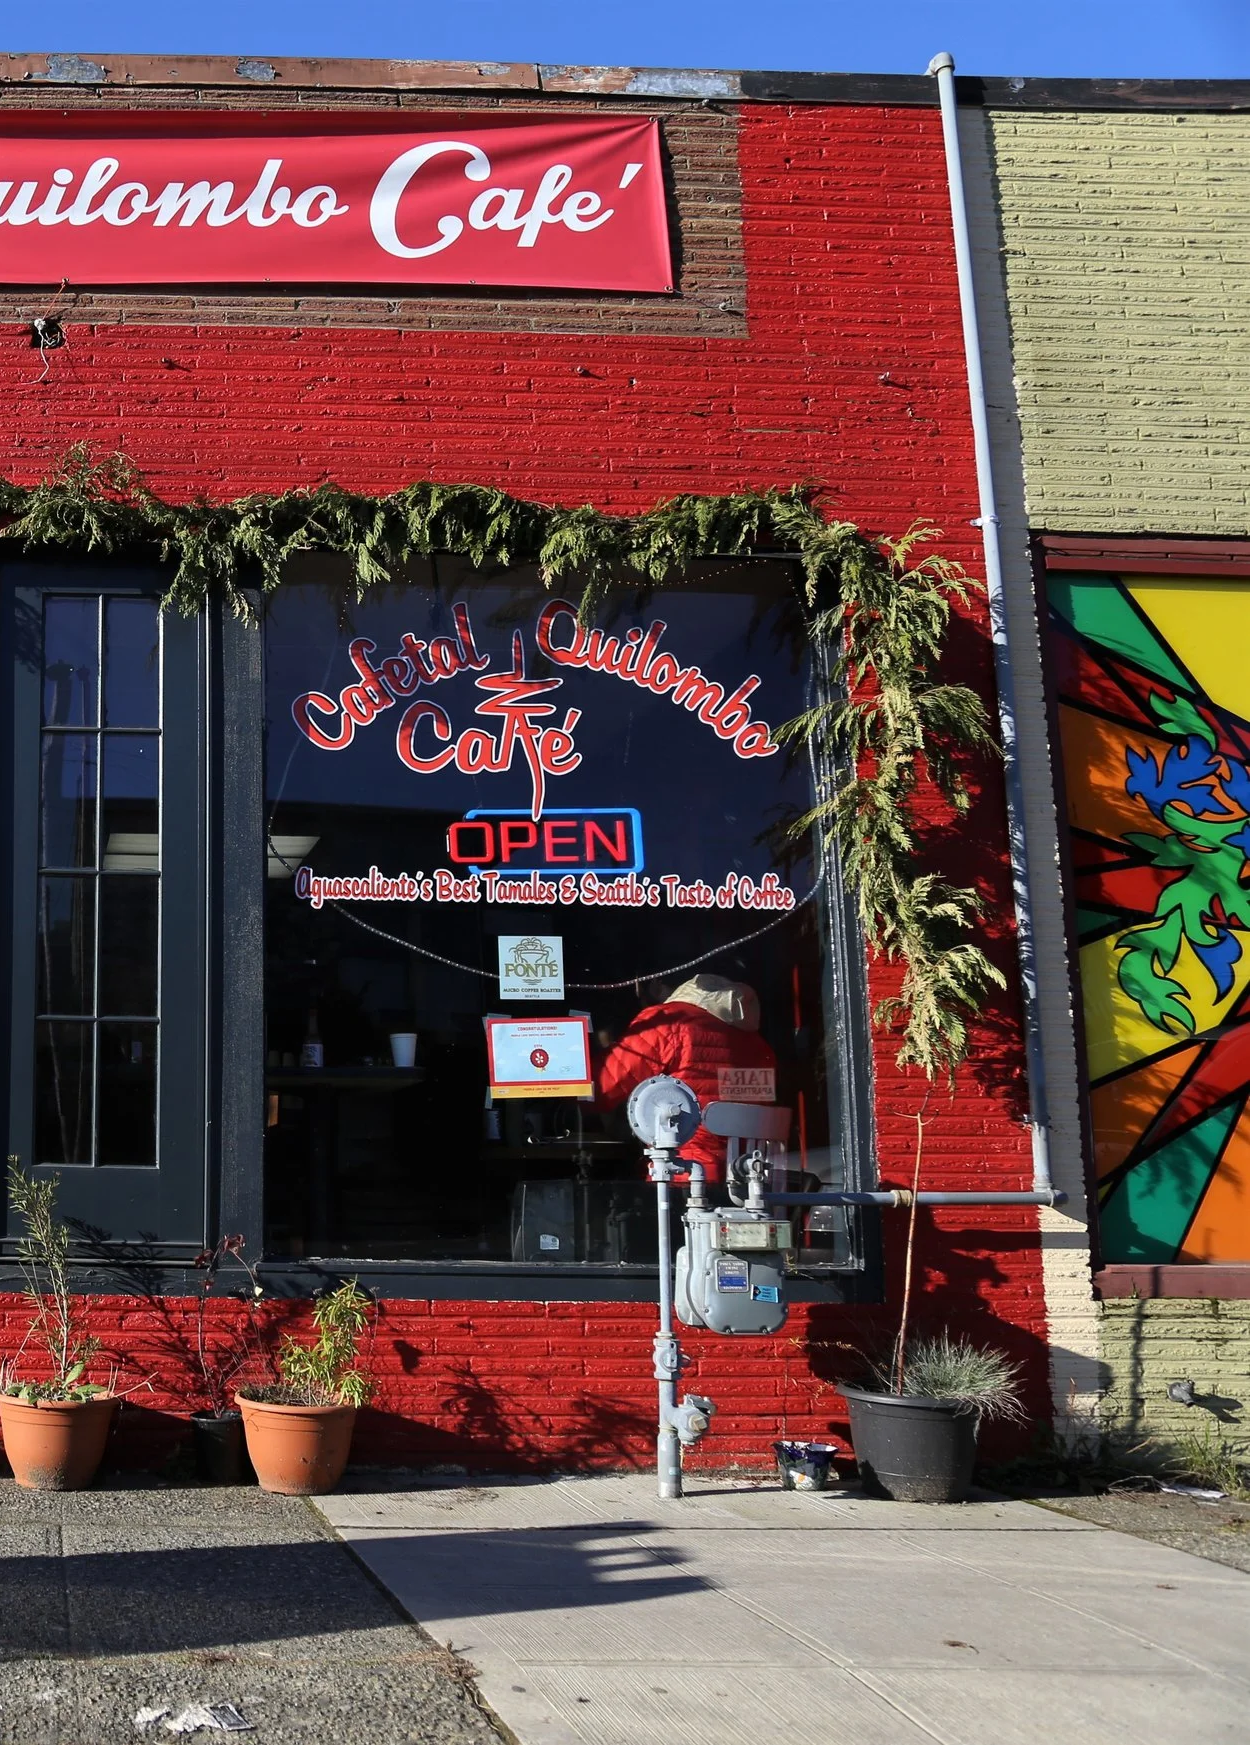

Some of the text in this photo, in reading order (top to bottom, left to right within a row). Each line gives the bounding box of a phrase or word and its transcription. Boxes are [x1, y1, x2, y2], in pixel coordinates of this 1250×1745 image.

[292, 599, 779, 759] Cafetal Quilombo
[448, 820, 627, 863] OPEN
[295, 866, 796, 910] Aguascaliente's Best Tamales & Seattle's Taste of Coffee
